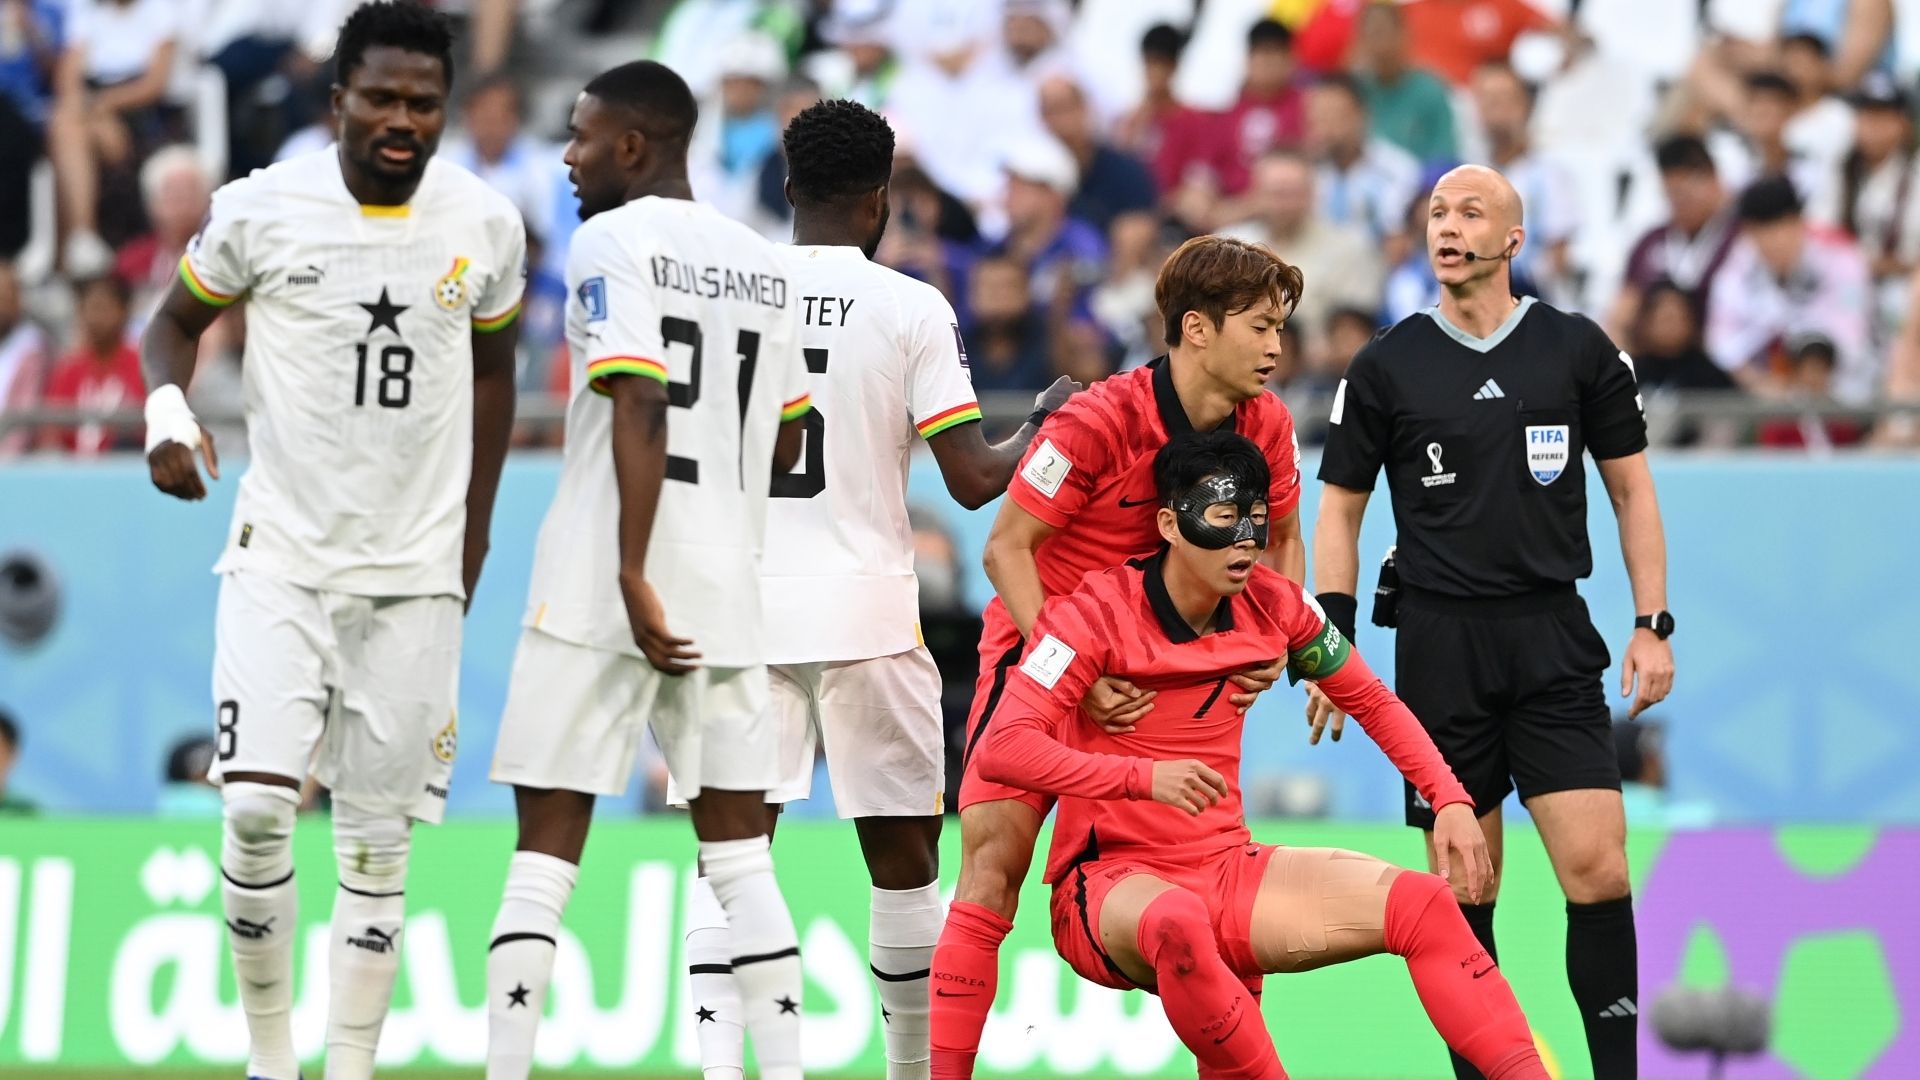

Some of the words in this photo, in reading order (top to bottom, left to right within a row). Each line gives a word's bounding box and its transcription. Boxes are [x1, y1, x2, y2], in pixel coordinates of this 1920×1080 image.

[355, 342, 414, 409] 18
[660, 315, 761, 492] 21
[1531, 430, 1564, 443] FIFA
[1531, 452, 1564, 461] REFEREE
[934, 972, 986, 988] KOREA
[1200, 996, 1241, 1034] KOREA
